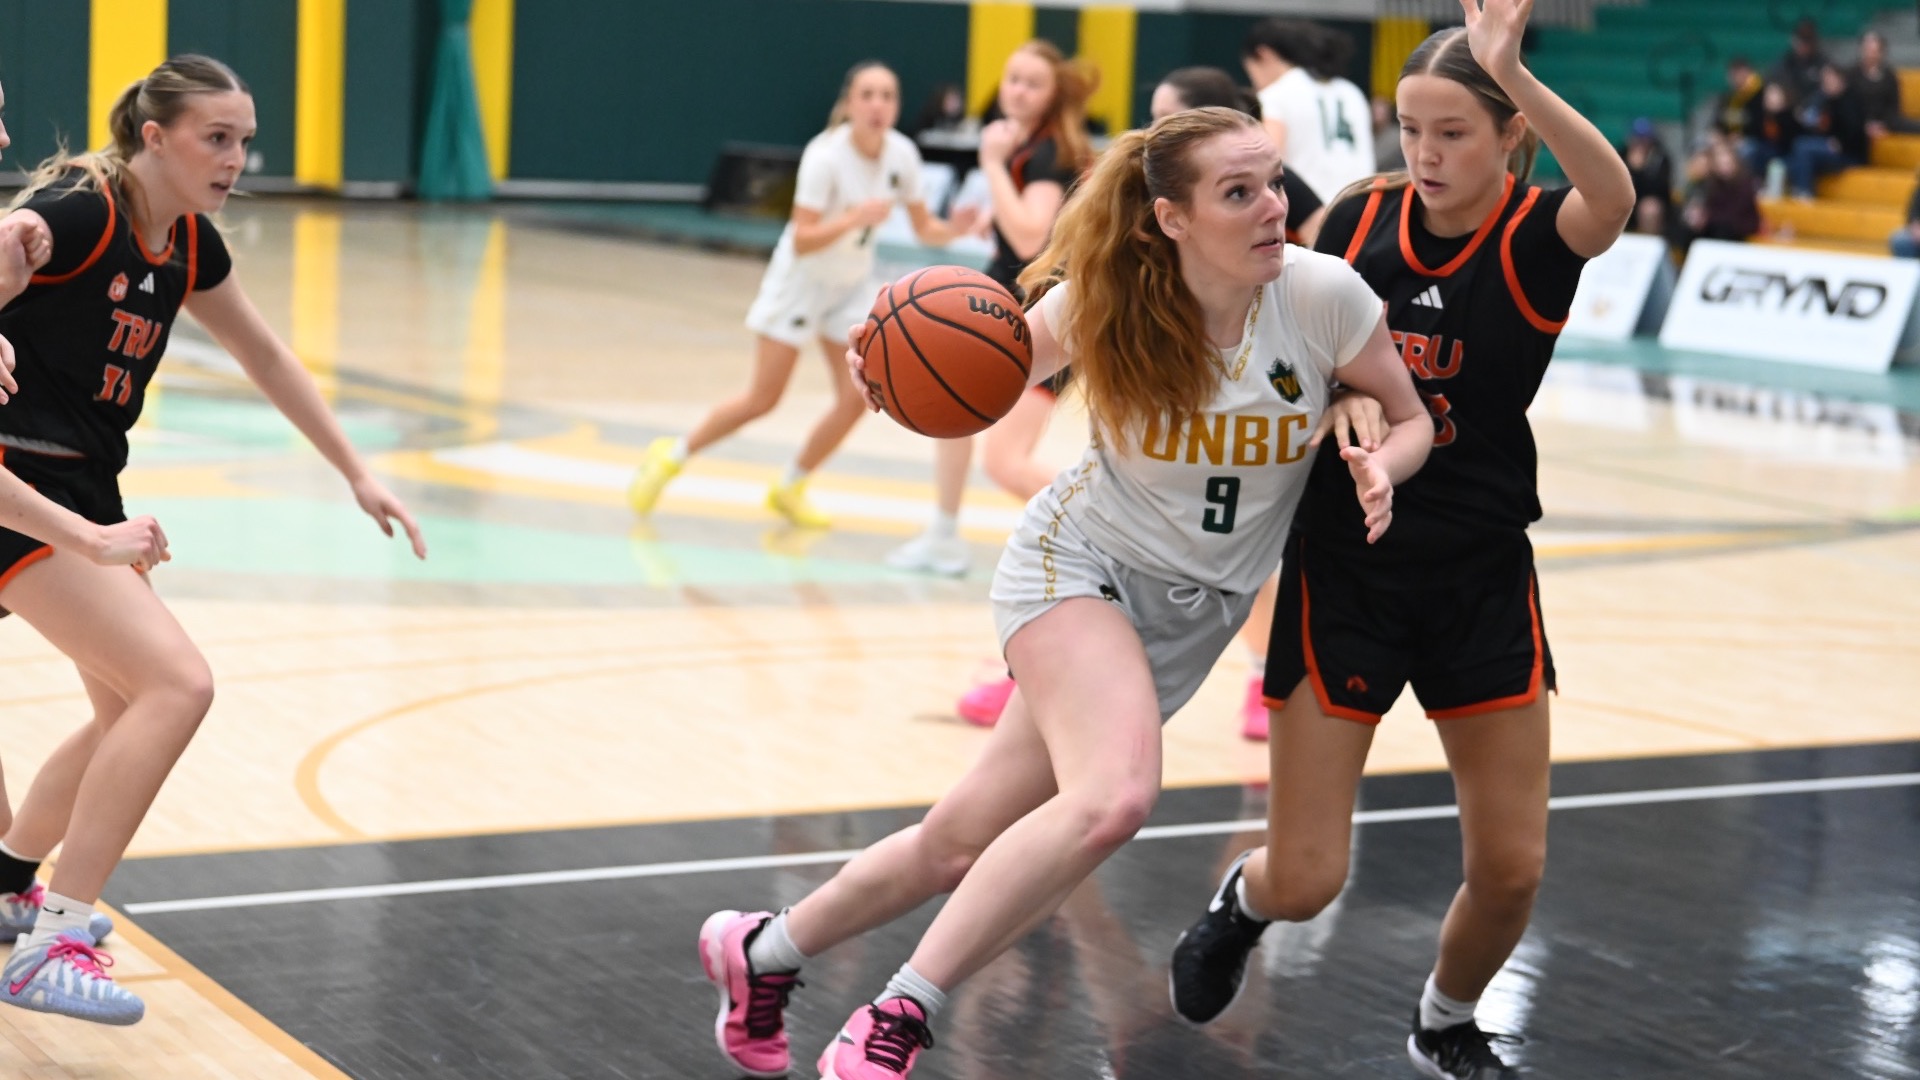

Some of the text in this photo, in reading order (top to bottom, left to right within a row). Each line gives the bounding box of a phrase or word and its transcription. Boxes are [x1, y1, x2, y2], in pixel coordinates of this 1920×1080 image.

[1317, 96, 1355, 150] 14
[107, 308, 163, 360] TRU
[1142, 413, 1308, 466] UNBC
[1201, 476, 1241, 534] 9
